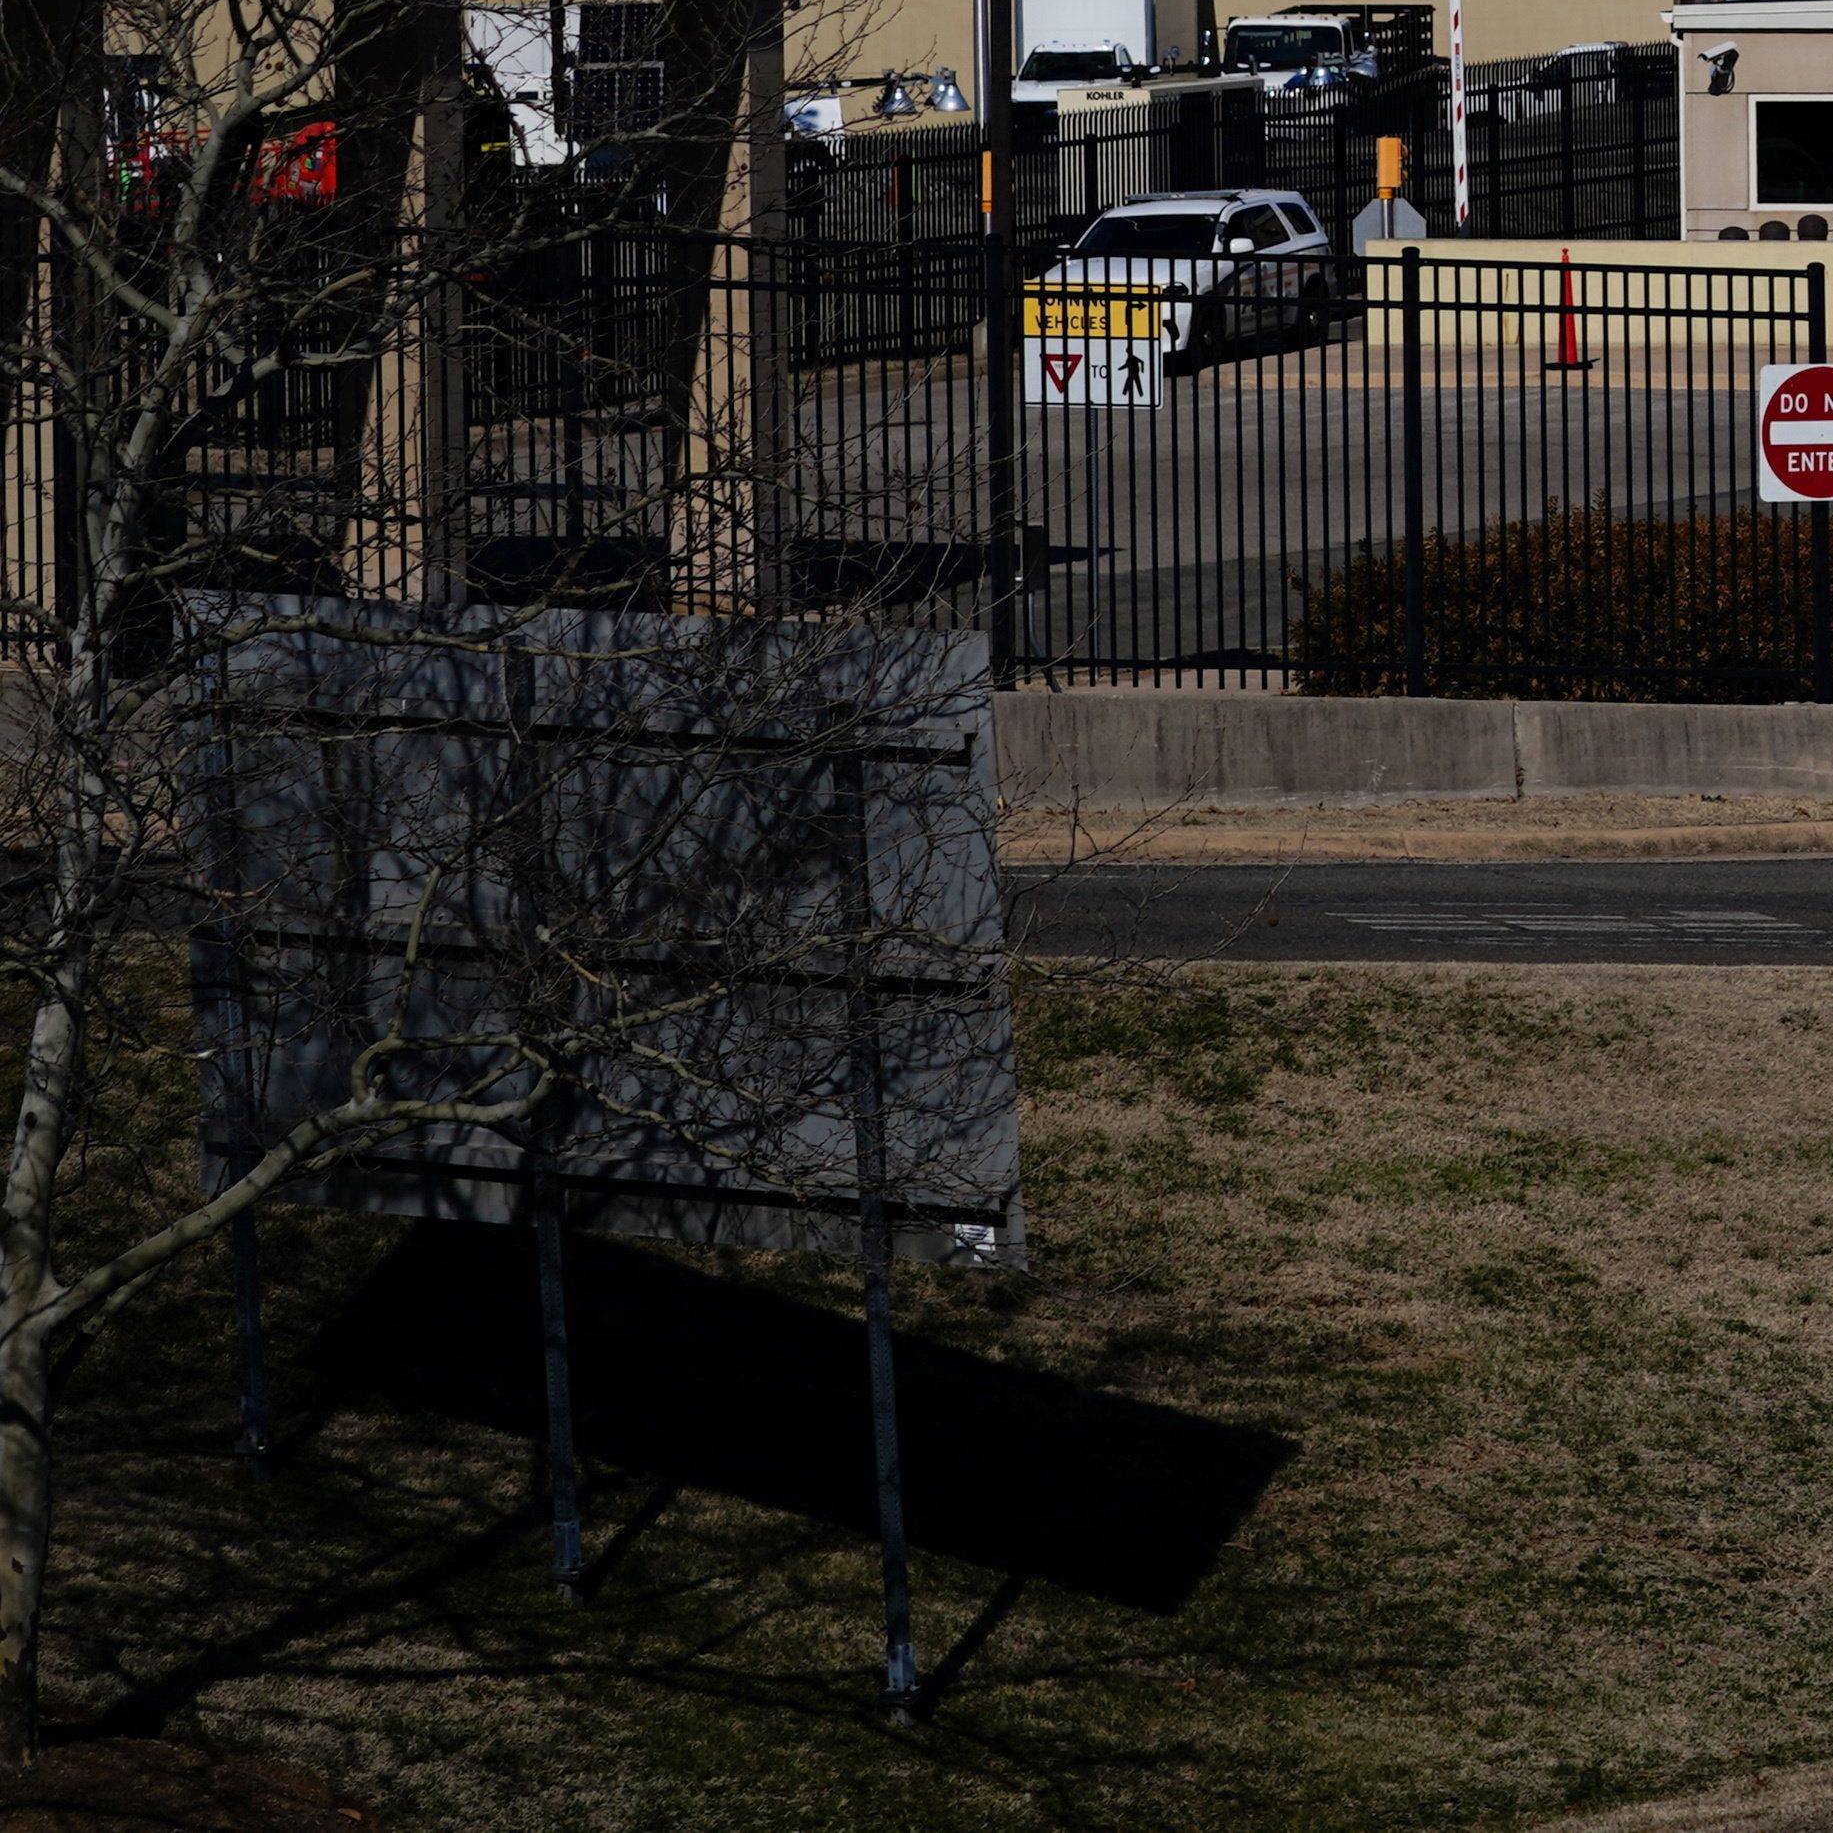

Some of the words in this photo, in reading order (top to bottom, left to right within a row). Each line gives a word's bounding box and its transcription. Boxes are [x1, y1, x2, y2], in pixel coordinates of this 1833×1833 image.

[1086, 91, 1124, 100] KOHLER
[1035, 316, 1109, 329] VEHCLES
[1091, 365, 1109, 378] TO
[1780, 393, 1808, 413] DO
